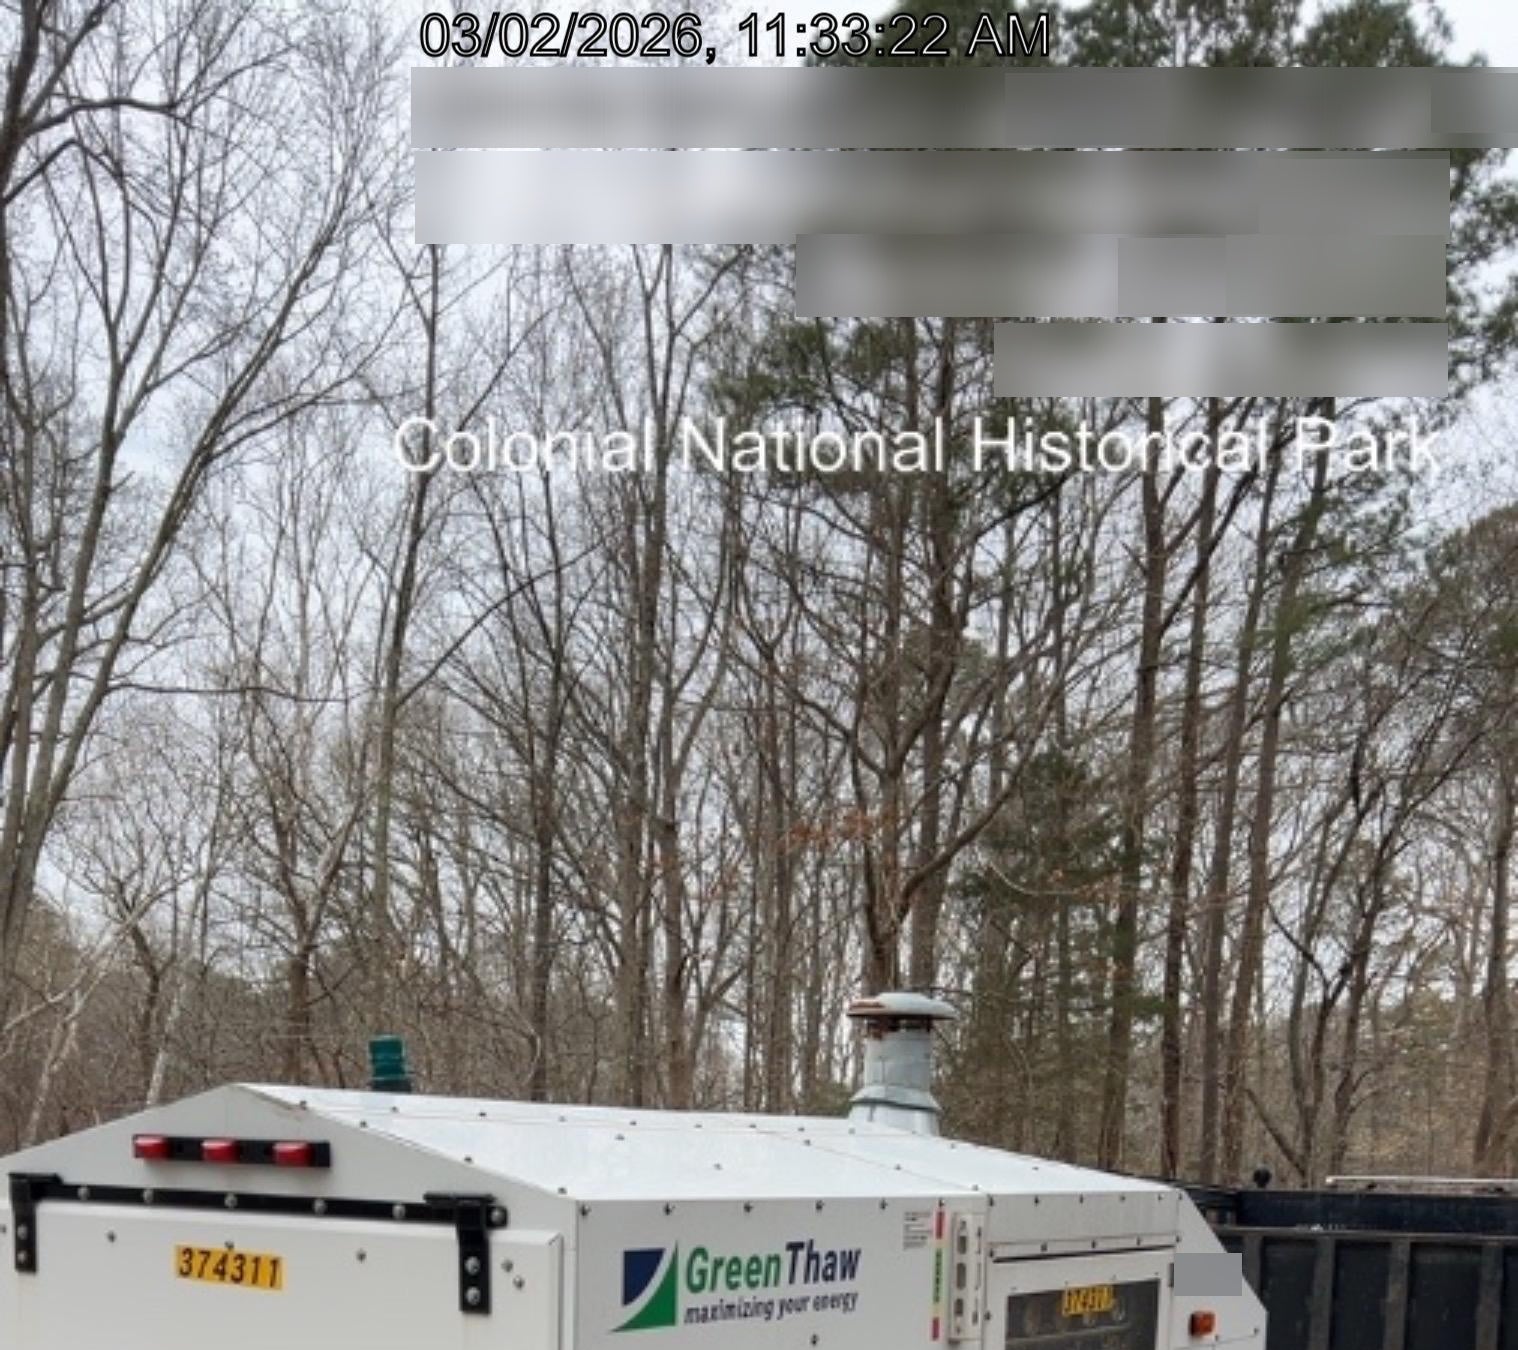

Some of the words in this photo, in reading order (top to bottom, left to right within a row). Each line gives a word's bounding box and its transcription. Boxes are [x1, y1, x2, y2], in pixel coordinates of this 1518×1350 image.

[178, 1247, 282, 1288] 374311
[683, 1297, 774, 1324] maximizing
[776, 1296, 811, 1321] your
[812, 1291, 859, 1315] energy
